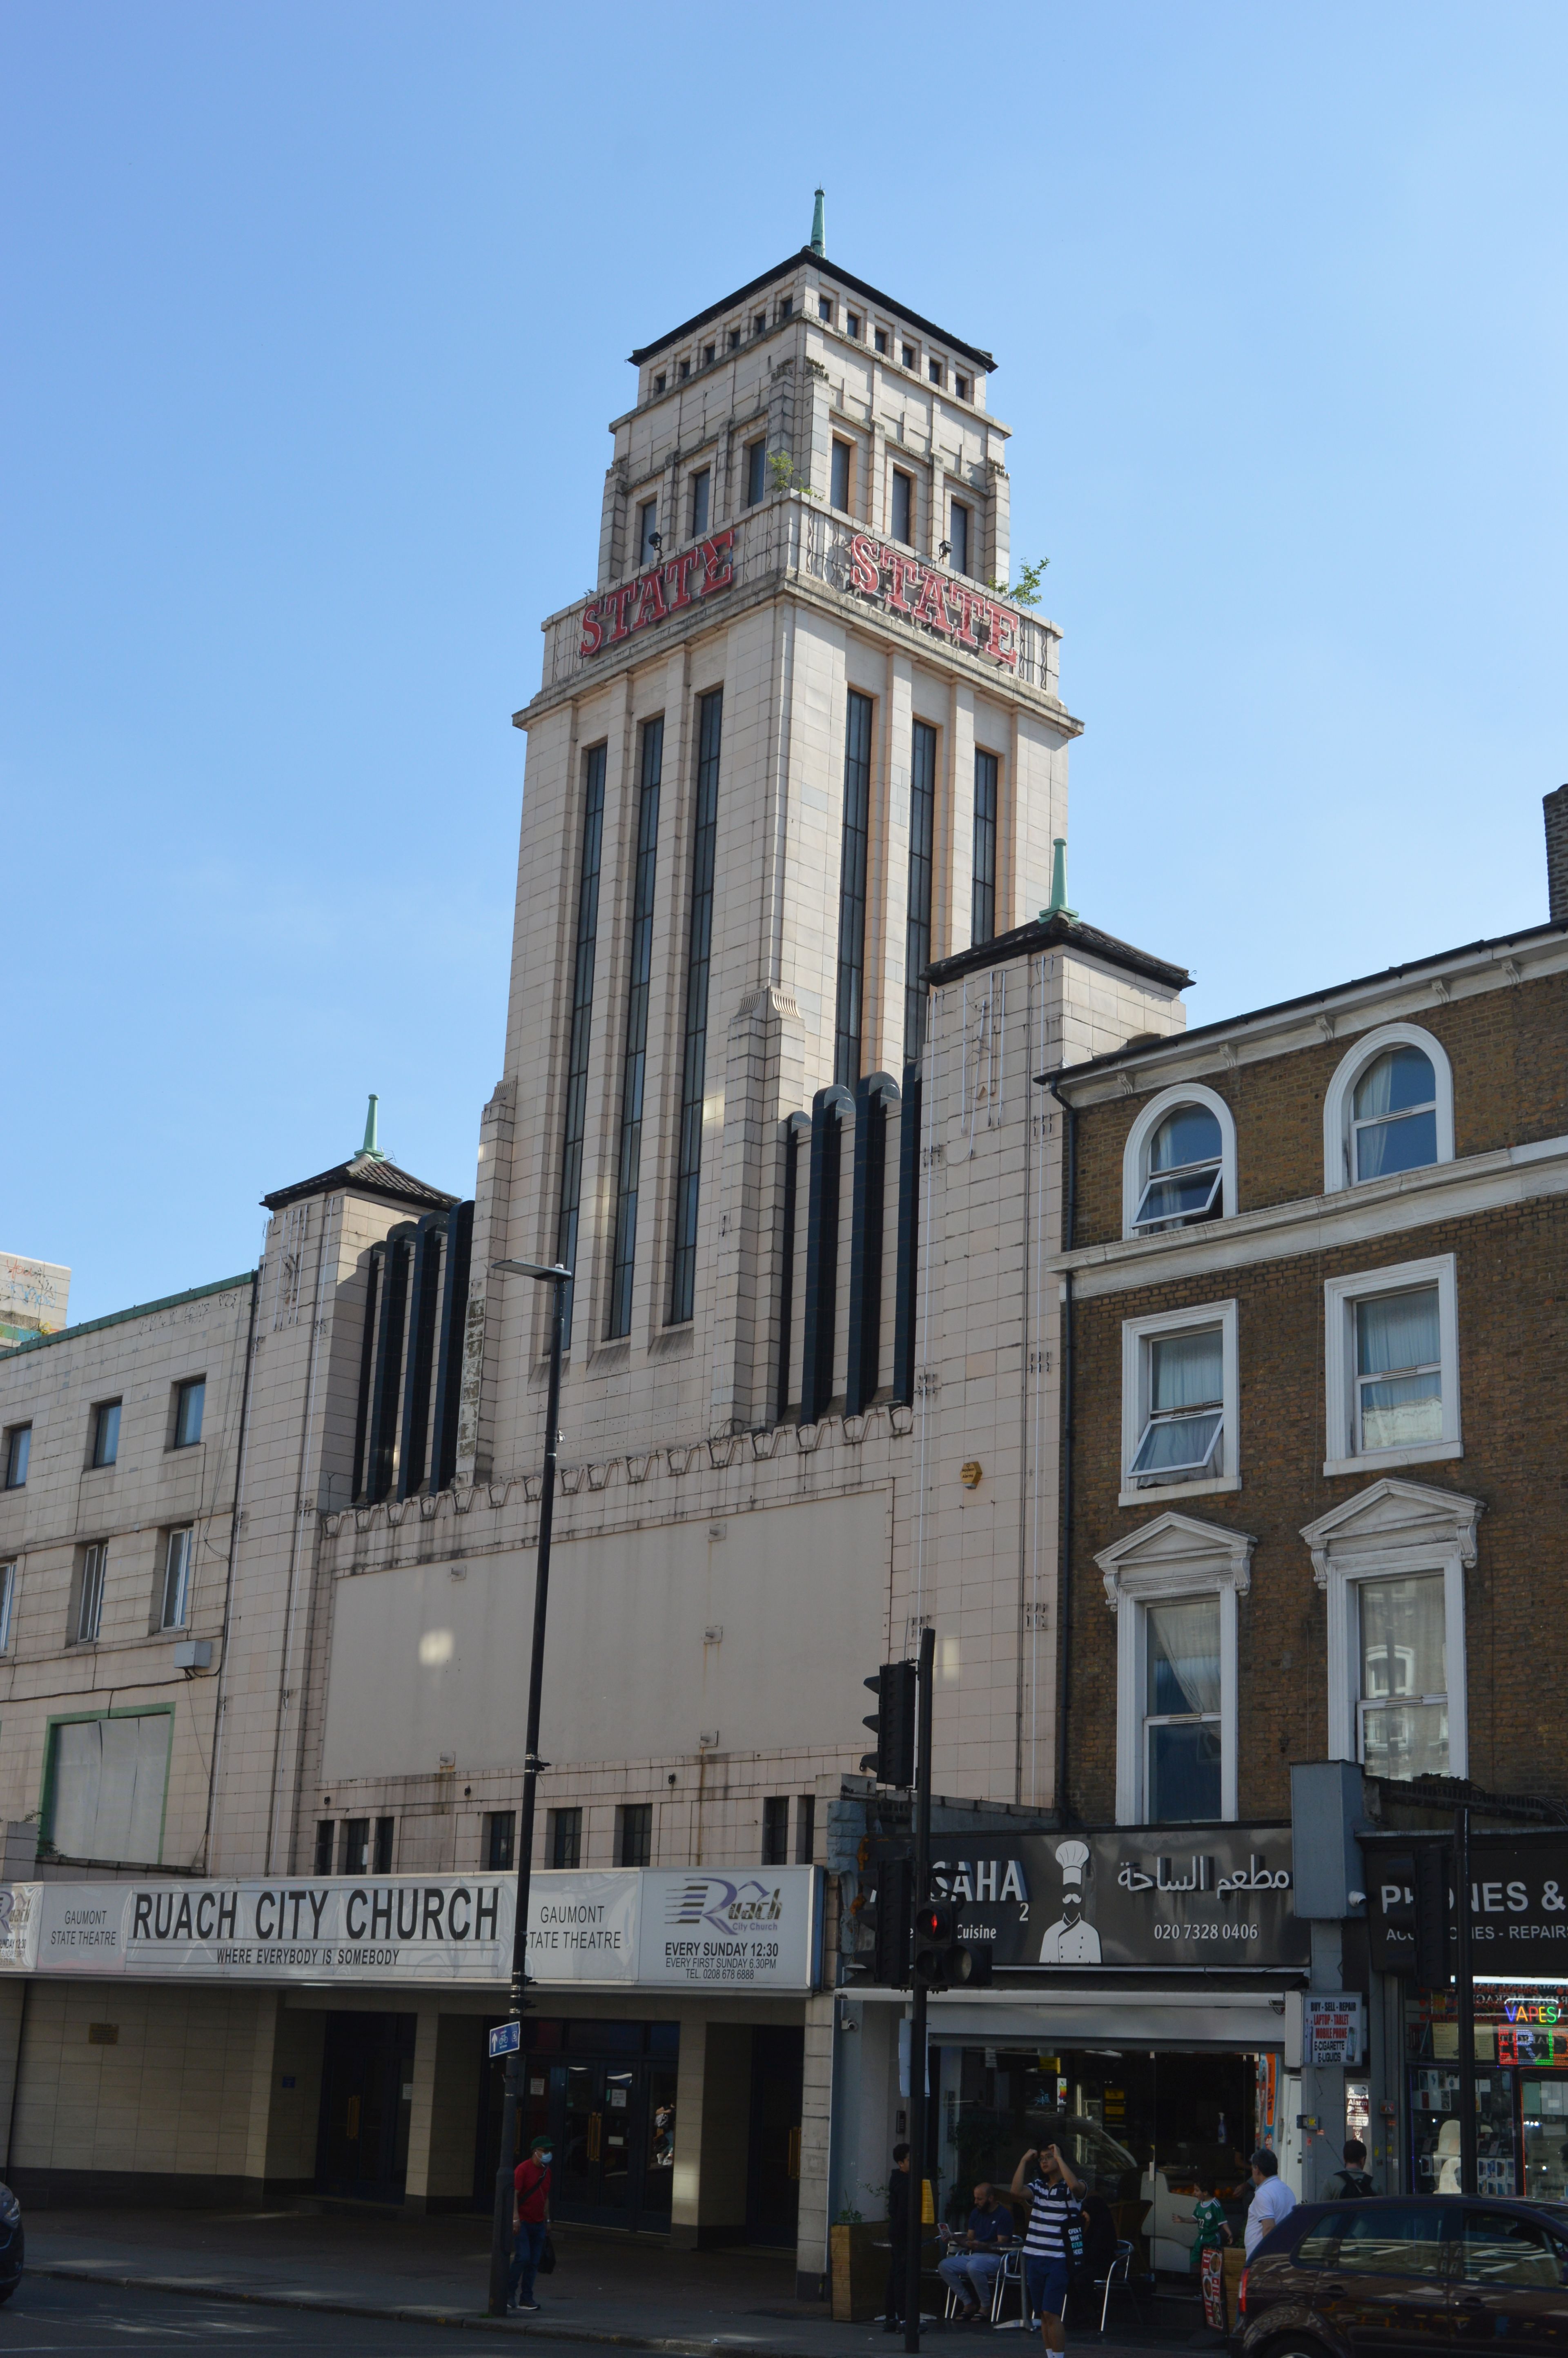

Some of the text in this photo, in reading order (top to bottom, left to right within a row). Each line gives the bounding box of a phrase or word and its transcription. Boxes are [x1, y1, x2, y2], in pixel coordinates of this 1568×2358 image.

[578, 530, 735, 659] STATE
[851, 534, 1020, 667] STATE
[1118, 1854, 1290, 1899] مطعم الساحة
[1381, 1880, 1566, 1913] PNES &
[65, 1910, 107, 1924] GAUMONT
[133, 1888, 499, 1940] RUACH CITY CHURCH
[541, 1906, 604, 1924] GAUMONT
[1020, 1902, 1029, 1921] 2
[733, 1923, 747, 1931] City
[958, 1924, 996, 1939] Cuisine
[1154, 1924, 1258, 1939] 020 7328 0406
[0, 1939, 15, 1949] UNDAY
[51, 1931, 116, 1945] STATE THEATRE
[530, 1932, 621, 1949] TATE THEATRE
[217, 1949, 400, 1965] WHERE EVERYBODY IS SOMEBODY
[665, 1942, 779, 1957] EVERY SUNDAY 12:30
[666, 1957, 776, 1969] EVERY FIRST SUNDAY 6.30PM
[686, 1968, 754, 1979] TEL. 0208 678 6888
[1311, 2002, 1356, 2011] BUY SELL REPAIR
[1505, 2005, 1557, 2023] VAPES
[1314, 2014, 1349, 2025] LAPTOP TABLET
[1316, 2028, 1347, 2039] MOBILE PHONE
[1314, 2041, 1345, 2051] E-CIGARETTE
[1318, 2052, 1341, 2062] E-LIQUIDS
